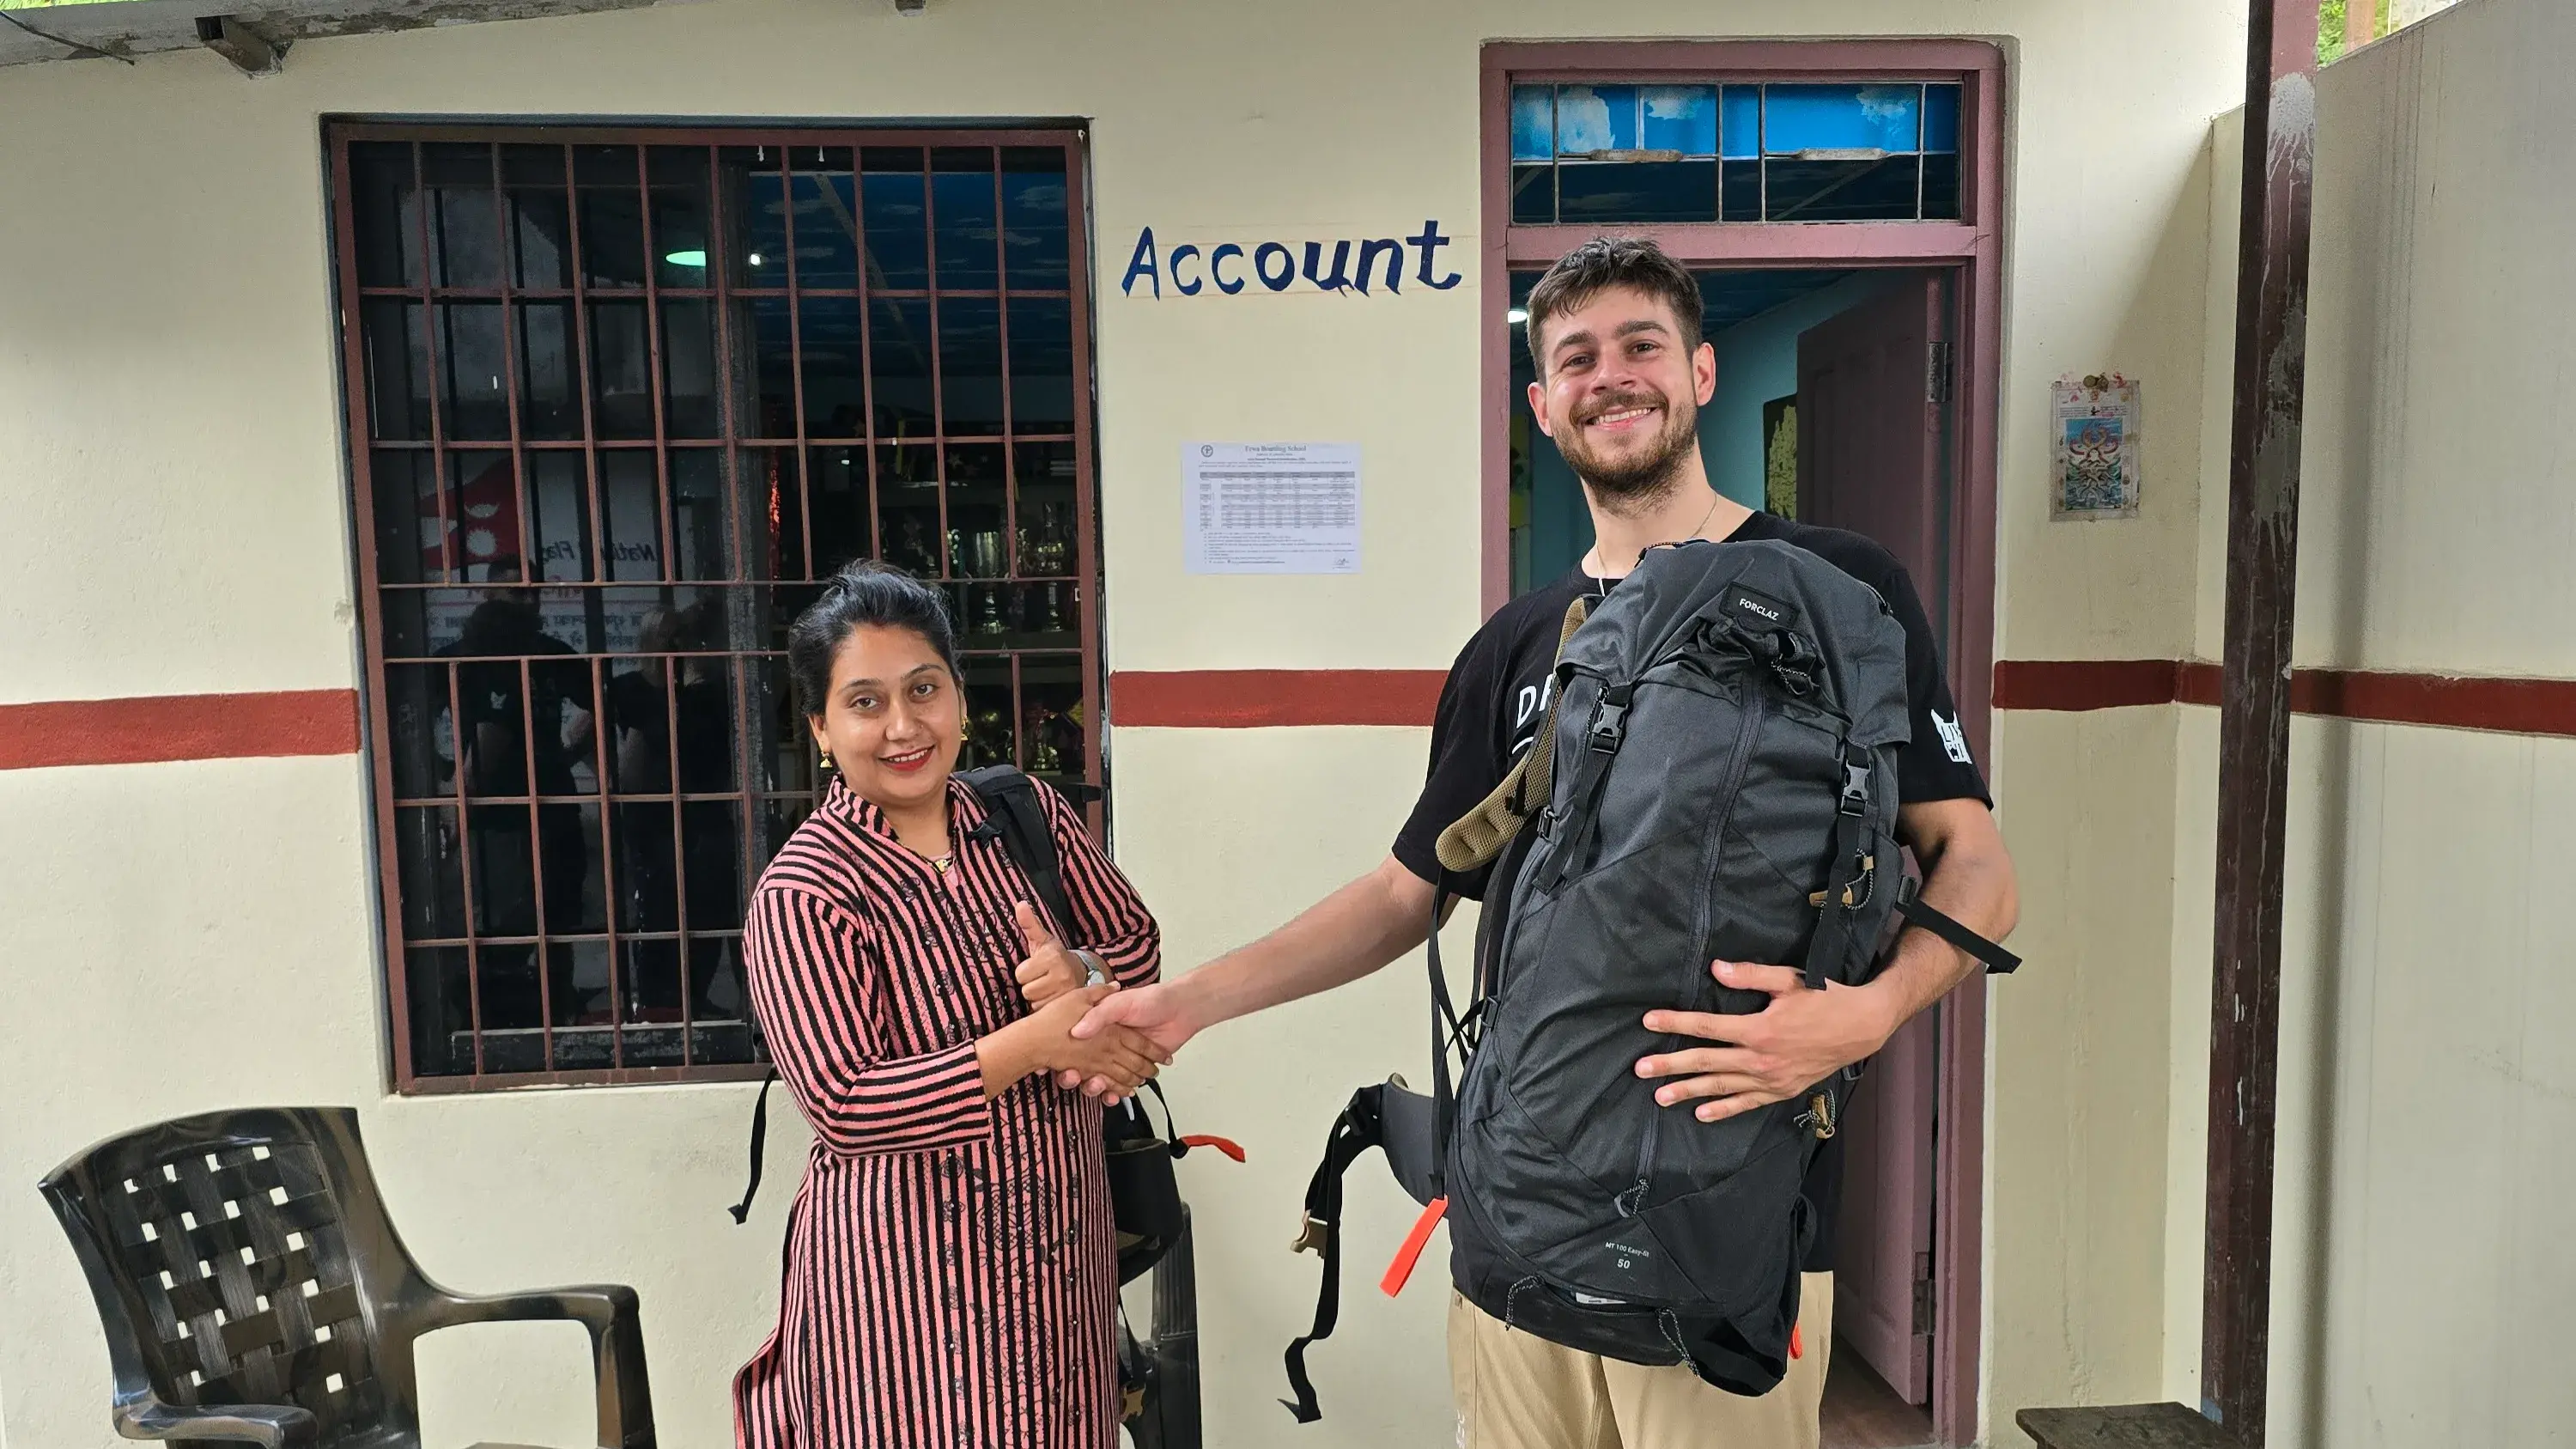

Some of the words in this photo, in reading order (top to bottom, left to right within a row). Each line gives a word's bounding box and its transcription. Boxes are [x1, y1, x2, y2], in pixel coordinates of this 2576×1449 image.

[1121, 220, 1462, 301] Account
[1739, 598, 1779, 620] FORCLAZ
[1616, 1244, 1627, 1252] 100
[1617, 1258, 1631, 1269] 50
